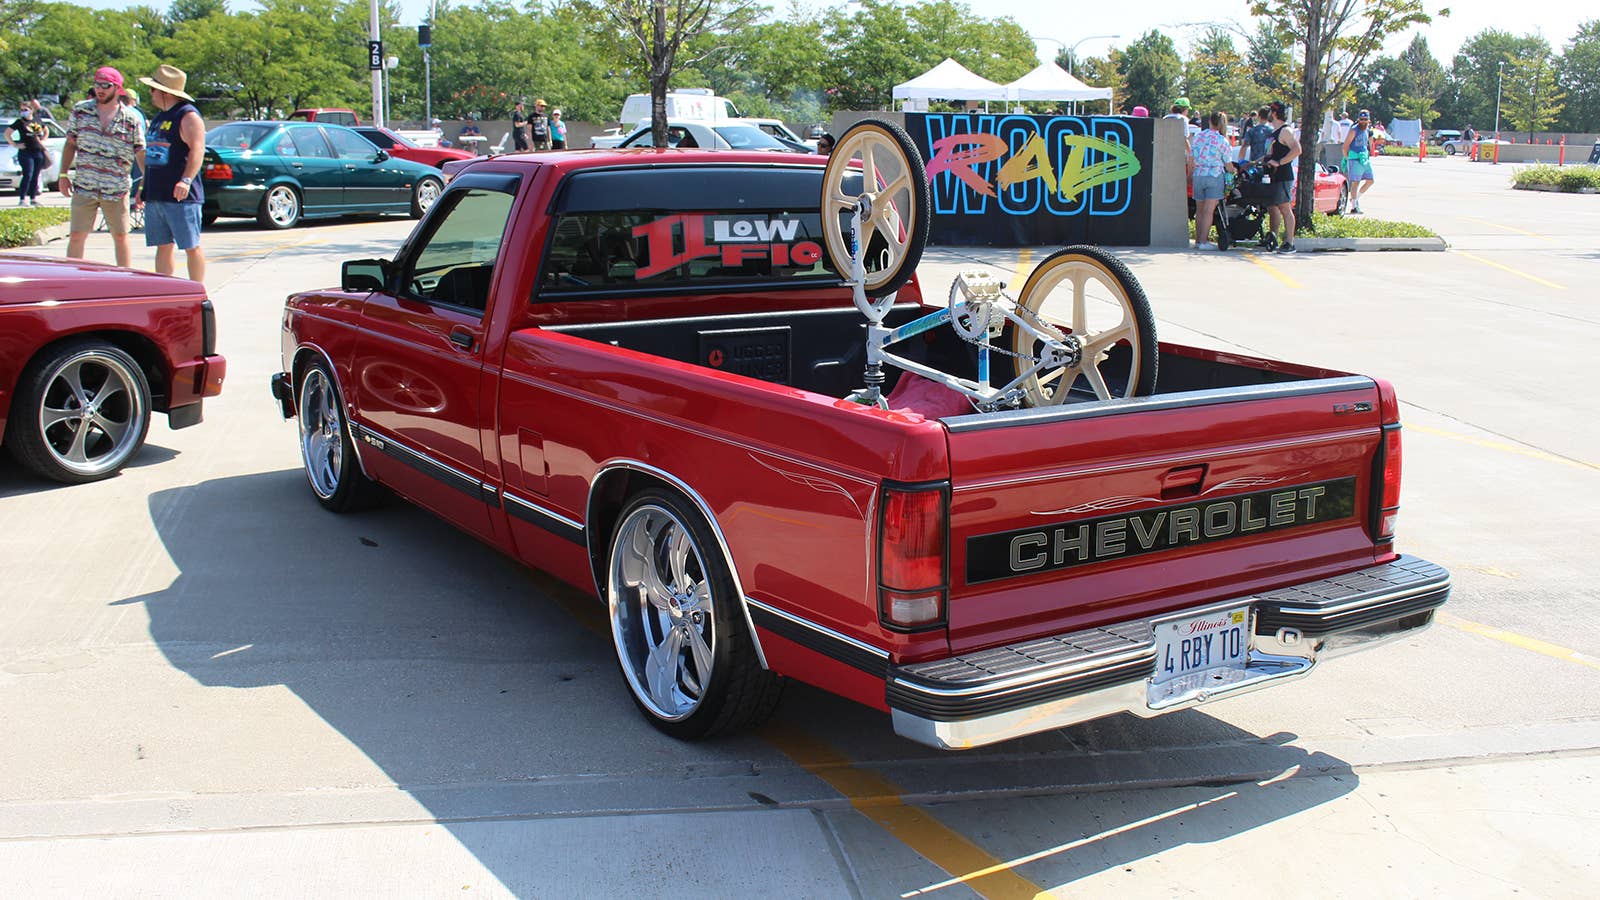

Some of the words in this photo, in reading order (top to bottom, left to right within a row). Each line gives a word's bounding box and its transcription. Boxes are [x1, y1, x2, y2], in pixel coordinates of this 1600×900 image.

[372, 44, 380, 54] 2
[372, 55, 380, 65] B
[925, 115, 1133, 215] WOOD
[925, 132, 1142, 202] RAD
[714, 220, 799, 242] LOW
[1009, 487, 1325, 571] CHEVROLET
[1188, 618, 1228, 634] Illinois
[1164, 643, 1174, 673] 4
[1181, 633, 1213, 671] RBY
[1220, 627, 1240, 660] TO
